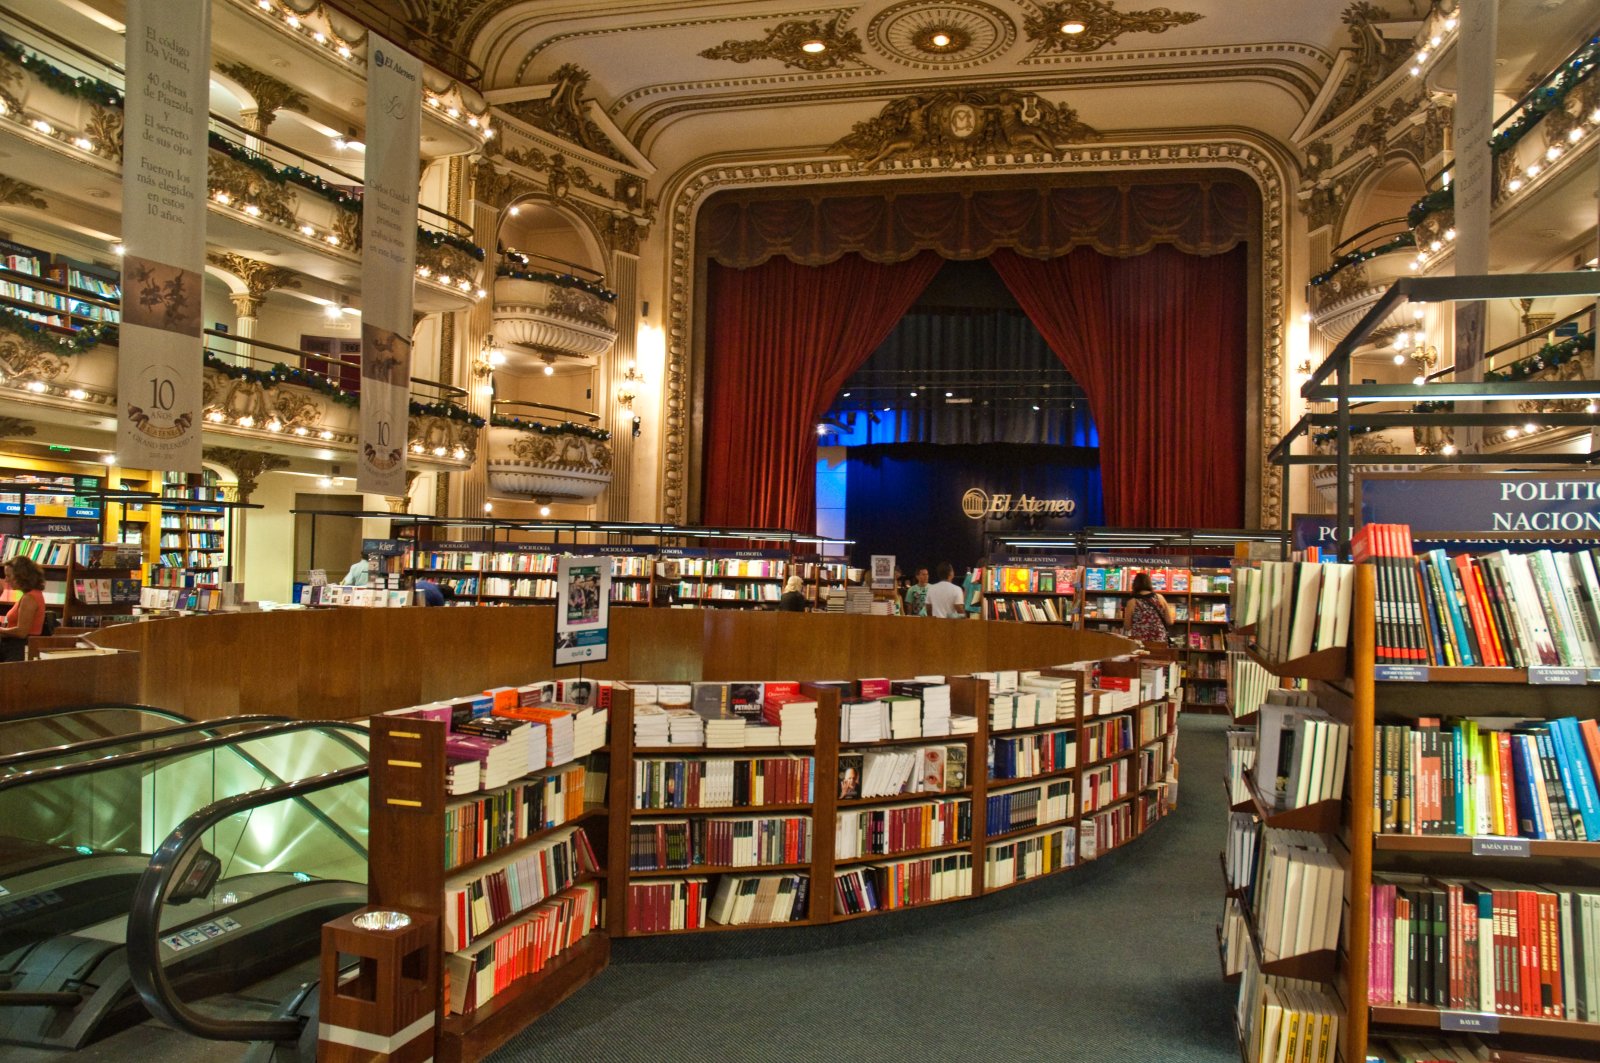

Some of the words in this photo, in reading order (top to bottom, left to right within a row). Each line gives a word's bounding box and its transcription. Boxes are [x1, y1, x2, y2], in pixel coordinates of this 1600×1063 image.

[146, 26, 156, 41] El
[159, 37, 190, 57] código
[145, 41, 159, 57] Da
[161, 48, 190, 73] Vinci,
[384, 56, 393, 68] El
[393, 63, 416, 82] Ateneo
[143, 84, 156, 99] de
[147, 72, 159, 86] 40
[161, 80, 188, 98] obras
[144, 114, 154, 128] El
[156, 122, 189, 141] secreto
[142, 129, 154, 142] de
[156, 137, 171, 149] sus
[172, 143, 192, 157] ojos
[140, 156, 174, 179] Fueron
[176, 168, 191, 184] los
[137, 173, 157, 187] más
[158, 179, 194, 200] elegidos
[146, 191, 160, 203] en
[161, 197, 185, 210] estos
[147, 202, 159, 216] 10
[160, 209, 185, 225] años.
[149, 377, 176, 411] 10
[376, 420, 391, 447] 10
[988, 493, 1012, 512] El
[1013, 493, 1076, 513] Ateneo
[1500, 481, 1600, 502] POLITI
[1107, 556, 1137, 564] TURISMO
[1137, 557, 1172, 565] NACIONAL
